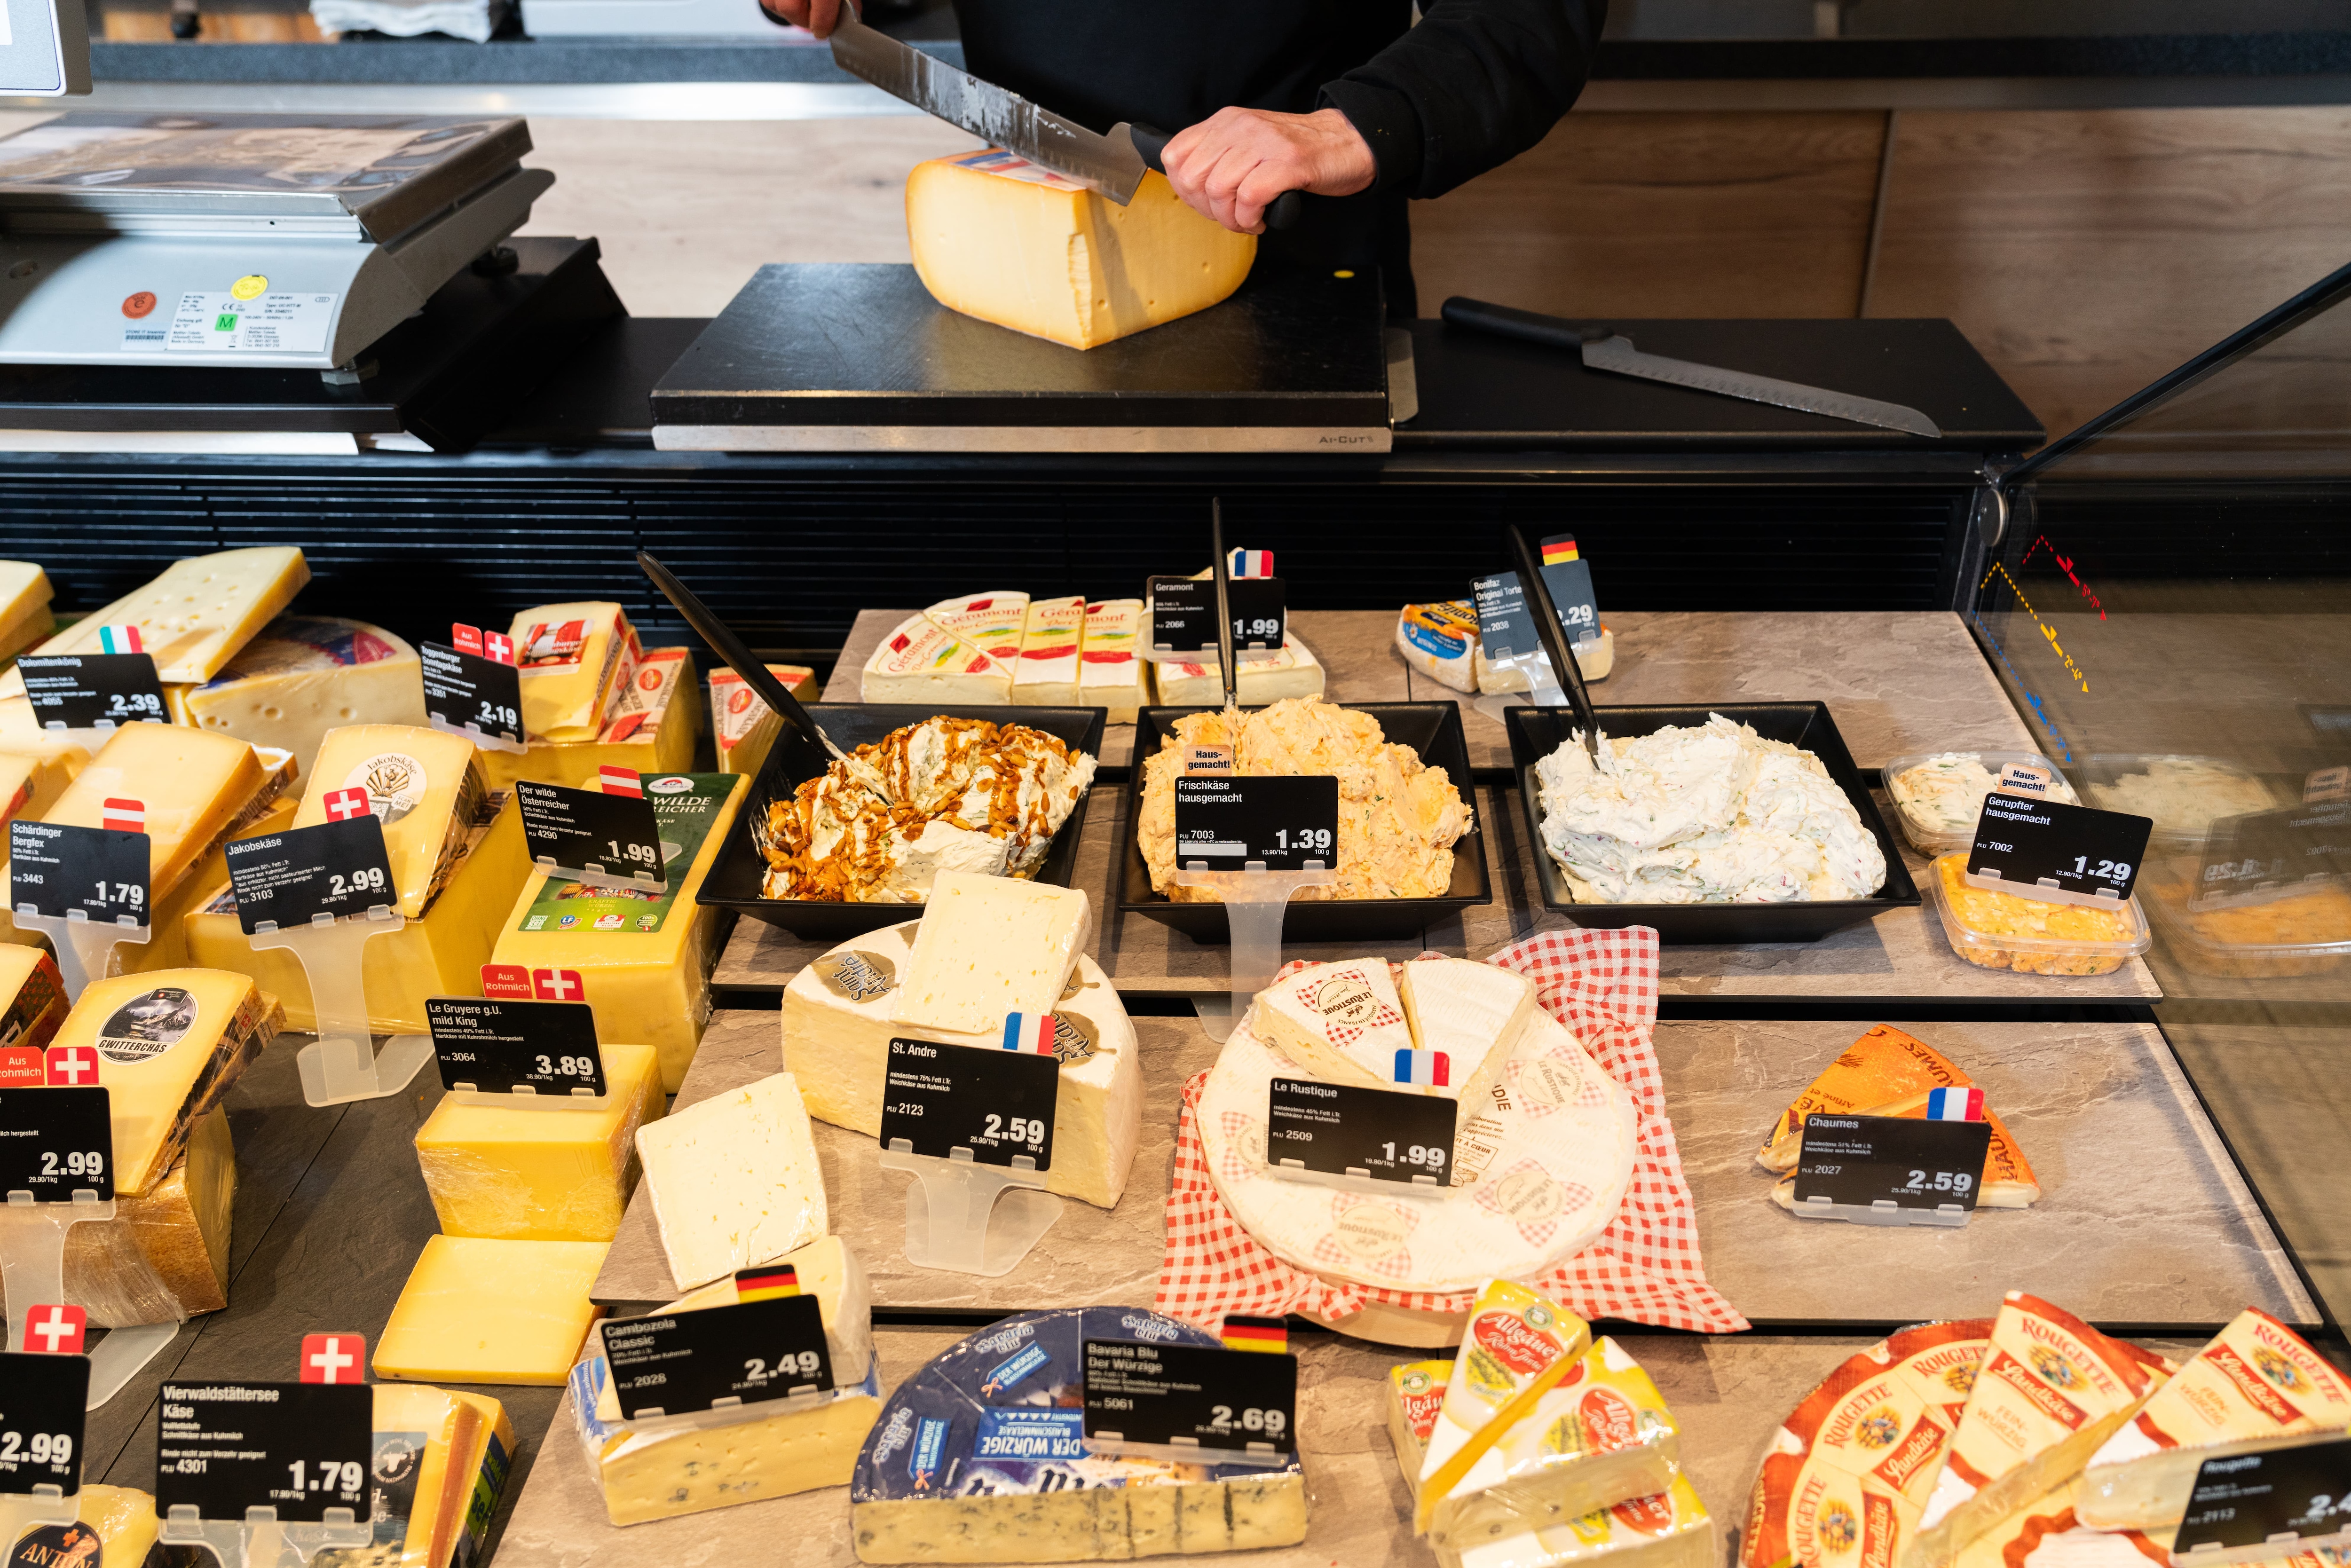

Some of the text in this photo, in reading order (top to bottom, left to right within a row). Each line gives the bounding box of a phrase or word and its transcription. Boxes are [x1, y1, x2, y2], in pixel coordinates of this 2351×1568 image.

[220, 317, 233, 328] M
[1474, 579, 1500, 591] Bonifaz
[1476, 585, 1523, 601] Original Torte
[1233, 619, 1279, 635] 1.99
[1491, 620, 1509, 632] 2038
[455, 638, 481, 650] Rohmilch
[421, 645, 460, 662] Toggenburger
[17, 657, 82, 667] Dolomitenkönig
[422, 656, 462, 674] Sonntagskäse
[432, 688, 446, 698] 3351
[110, 693, 160, 711] 2.39
[481, 701, 517, 725] 2.19
[1196, 750, 1223, 759] Haus-
[367, 755, 417, 775] Jakobskäse
[1188, 760, 1230, 770] gemacht!
[2012, 770, 2040, 780] Haus-
[519, 785, 556, 798] Der wilde
[1179, 780, 1230, 790] Frischkäse
[2002, 778, 2045, 791] gemacht!
[394, 801, 409, 809] ME!
[398, 796, 411, 804] SCAN
[521, 795, 570, 810] Österreicher
[654, 796, 712, 806] WILDE
[1179, 793, 1242, 804] hausgemacht
[1988, 796, 2034, 812] Gerupfter
[1986, 807, 2051, 826] hausgemacht
[12, 824, 62, 838] Schärdinger
[538, 830, 557, 840] 4290
[1191, 830, 1214, 839] 7003
[12, 836, 44, 848] Bergfex
[1276, 829, 1331, 849] 1.39
[229, 838, 282, 856] Jakobskäse
[608, 840, 656, 863] 1.99
[1989, 841, 2013, 853] 7002
[599, 855, 621, 864] 19.90/1kg
[2055, 869, 2083, 880] 12.90/1kg
[2074, 856, 2132, 881] 1.29
[23, 873, 43, 884] 3443
[330, 867, 385, 896] 2.99
[96, 881, 144, 905] 1.79
[250, 889, 273, 902] 3103
[322, 895, 347, 904] 29.90/1kg
[84, 899, 106, 907] 17.90/1kg
[486, 983, 529, 992] Rohmilch
[429, 1003, 502, 1016] Le Gruyere g.U.
[432, 1016, 477, 1027] mild King
[98, 1039, 167, 1054] GWITTERCHÄS
[892, 1042, 937, 1058] St. Andre
[452, 1052, 476, 1062] 3064
[536, 1055, 594, 1076] 3.89
[890, 1072, 919, 1080] mindestens
[889, 1079, 916, 1087] Weichkäse
[927, 1083, 950, 1092] Kuhmilch
[1274, 1081, 1338, 1098] Le Rustique
[1823, 1095, 1855, 1109] Affiné
[899, 1103, 923, 1116] 2123
[984, 1114, 1045, 1144] 2.59
[1809, 1117, 1859, 1129] Chaumes
[970, 1136, 998, 1147] 25.90/1kg
[1286, 1130, 1312, 1142] 2509
[1382, 1141, 1446, 1166] 1.99
[41, 1151, 103, 1175] 2.99
[1365, 1157, 1395, 1167] 19.90/1kg
[1815, 1165, 1842, 1174] 2027
[29, 1175, 58, 1184] 29.90/1kg
[1906, 1170, 1972, 1191] 2.59
[605, 1318, 677, 1338] Cambozola
[608, 1334, 655, 1351] Classic
[1480, 1314, 1562, 1360] Allgäuer
[1087, 1343, 1159, 1360] Bavaria Blu
[744, 1350, 820, 1381] 2.49
[1088, 1356, 1111, 1369] Der
[1112, 1358, 1163, 1375] Würzige
[633, 1372, 667, 1387] 2028
[162, 1385, 279, 1402] Vierwaldstättersee
[1103, 1397, 1134, 1410] 5061
[162, 1403, 194, 1419] Käse
[1211, 1404, 1286, 1432] 2.69
[1823, 1382, 1893, 1449] ROUGETTE
[1, 1431, 73, 1464] 2.99
[980, 1436, 1081, 1458] DER WÜRZIGE
[176, 1458, 207, 1474] 4301
[288, 1460, 363, 1492] 1.79
